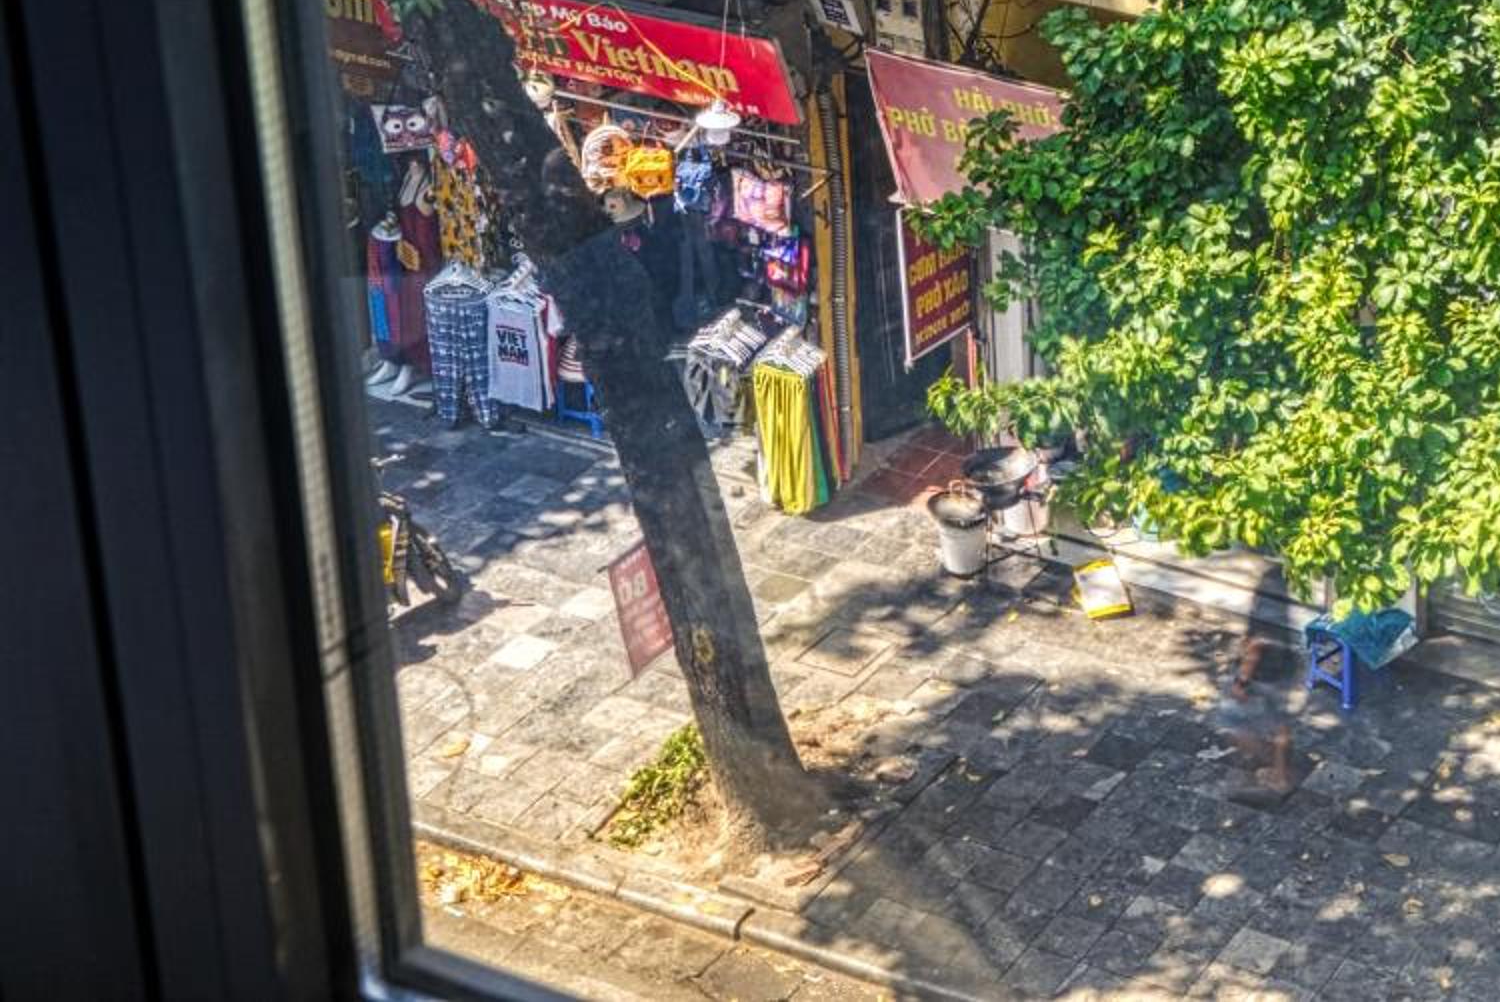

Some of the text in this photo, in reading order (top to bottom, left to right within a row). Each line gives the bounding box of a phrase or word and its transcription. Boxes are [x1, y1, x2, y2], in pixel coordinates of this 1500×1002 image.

[570, 28, 739, 92] Vietnam
[887, 106, 937, 137] PHỞ
[496, 329, 527, 348] VIET
[497, 344, 529, 361] NAM
